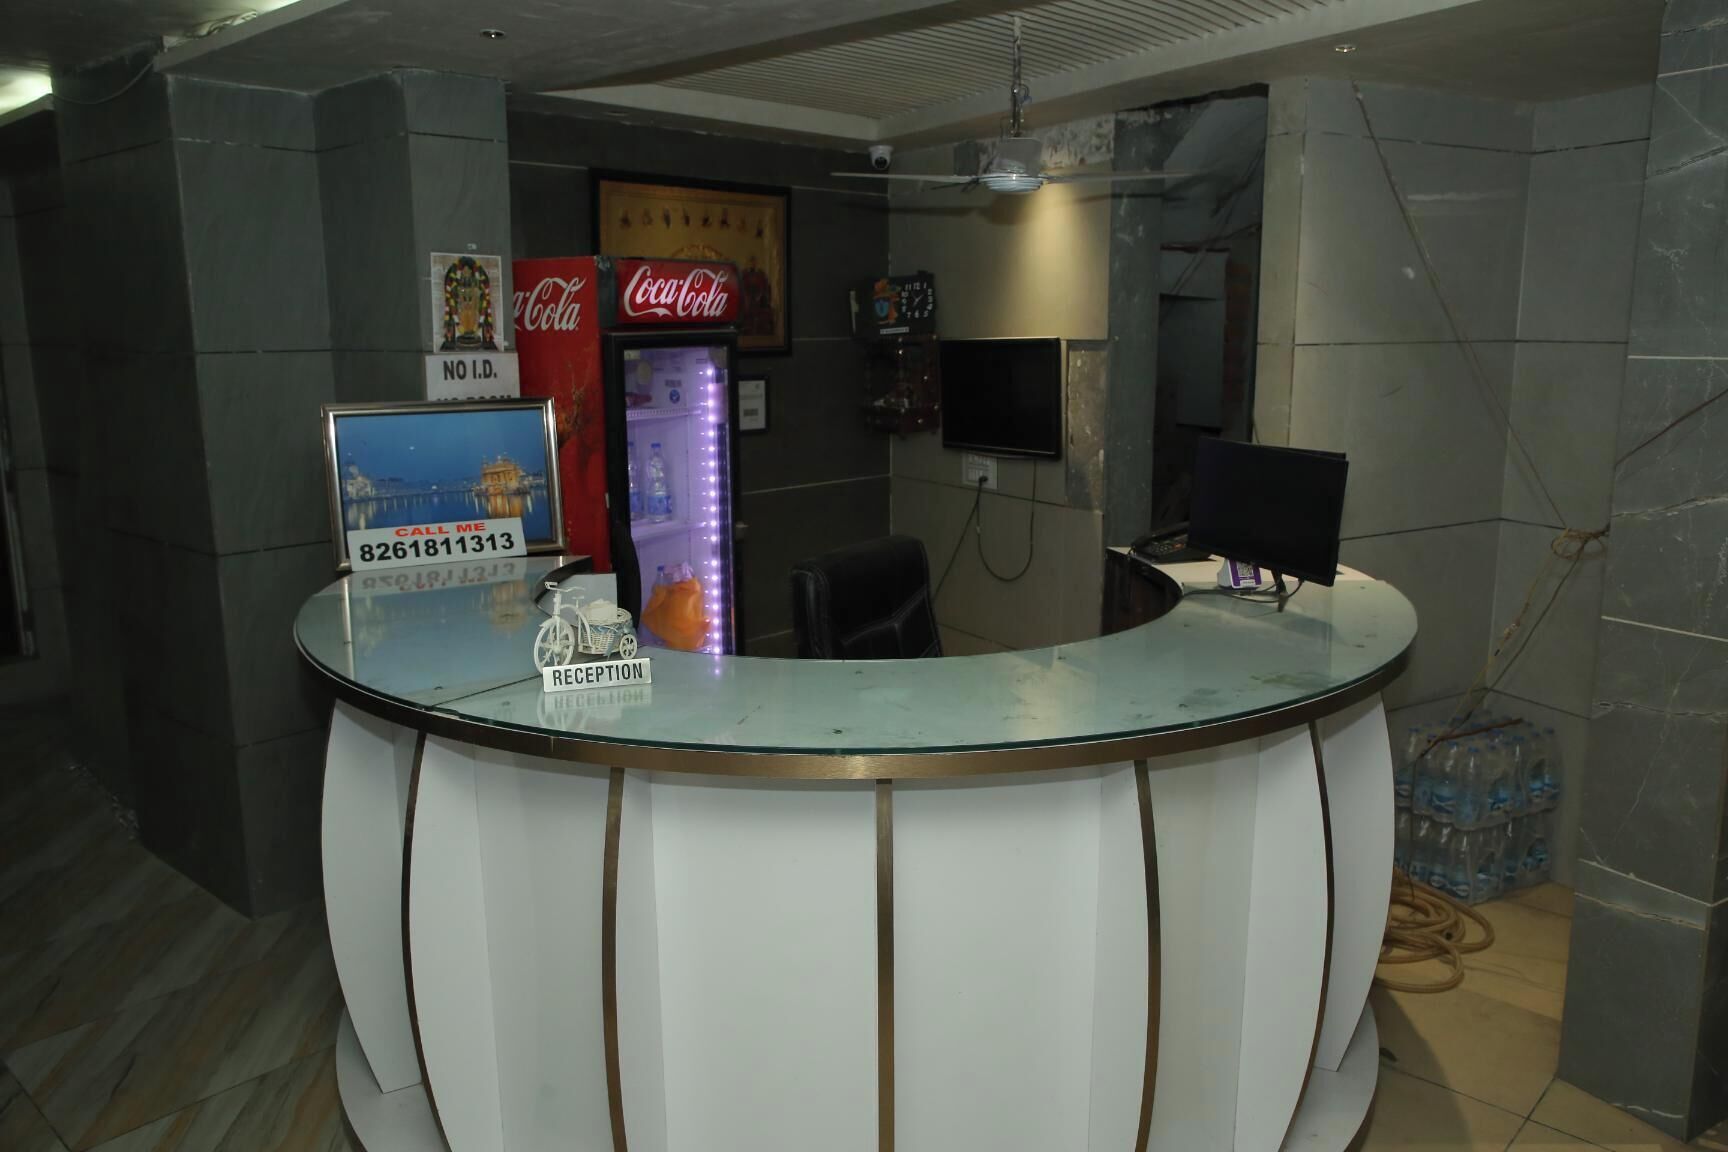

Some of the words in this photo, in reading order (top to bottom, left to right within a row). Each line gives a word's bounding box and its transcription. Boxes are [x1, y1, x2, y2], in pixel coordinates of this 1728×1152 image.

[624, 265, 729, 317] Coca-Cola
[443, 360, 467, 380] NO
[472, 359, 497, 379] I.D.
[394, 524, 449, 537] CALL
[456, 522, 487, 532] ME
[359, 532, 515, 562] 8261811313
[552, 662, 643, 686] RECEPTION
